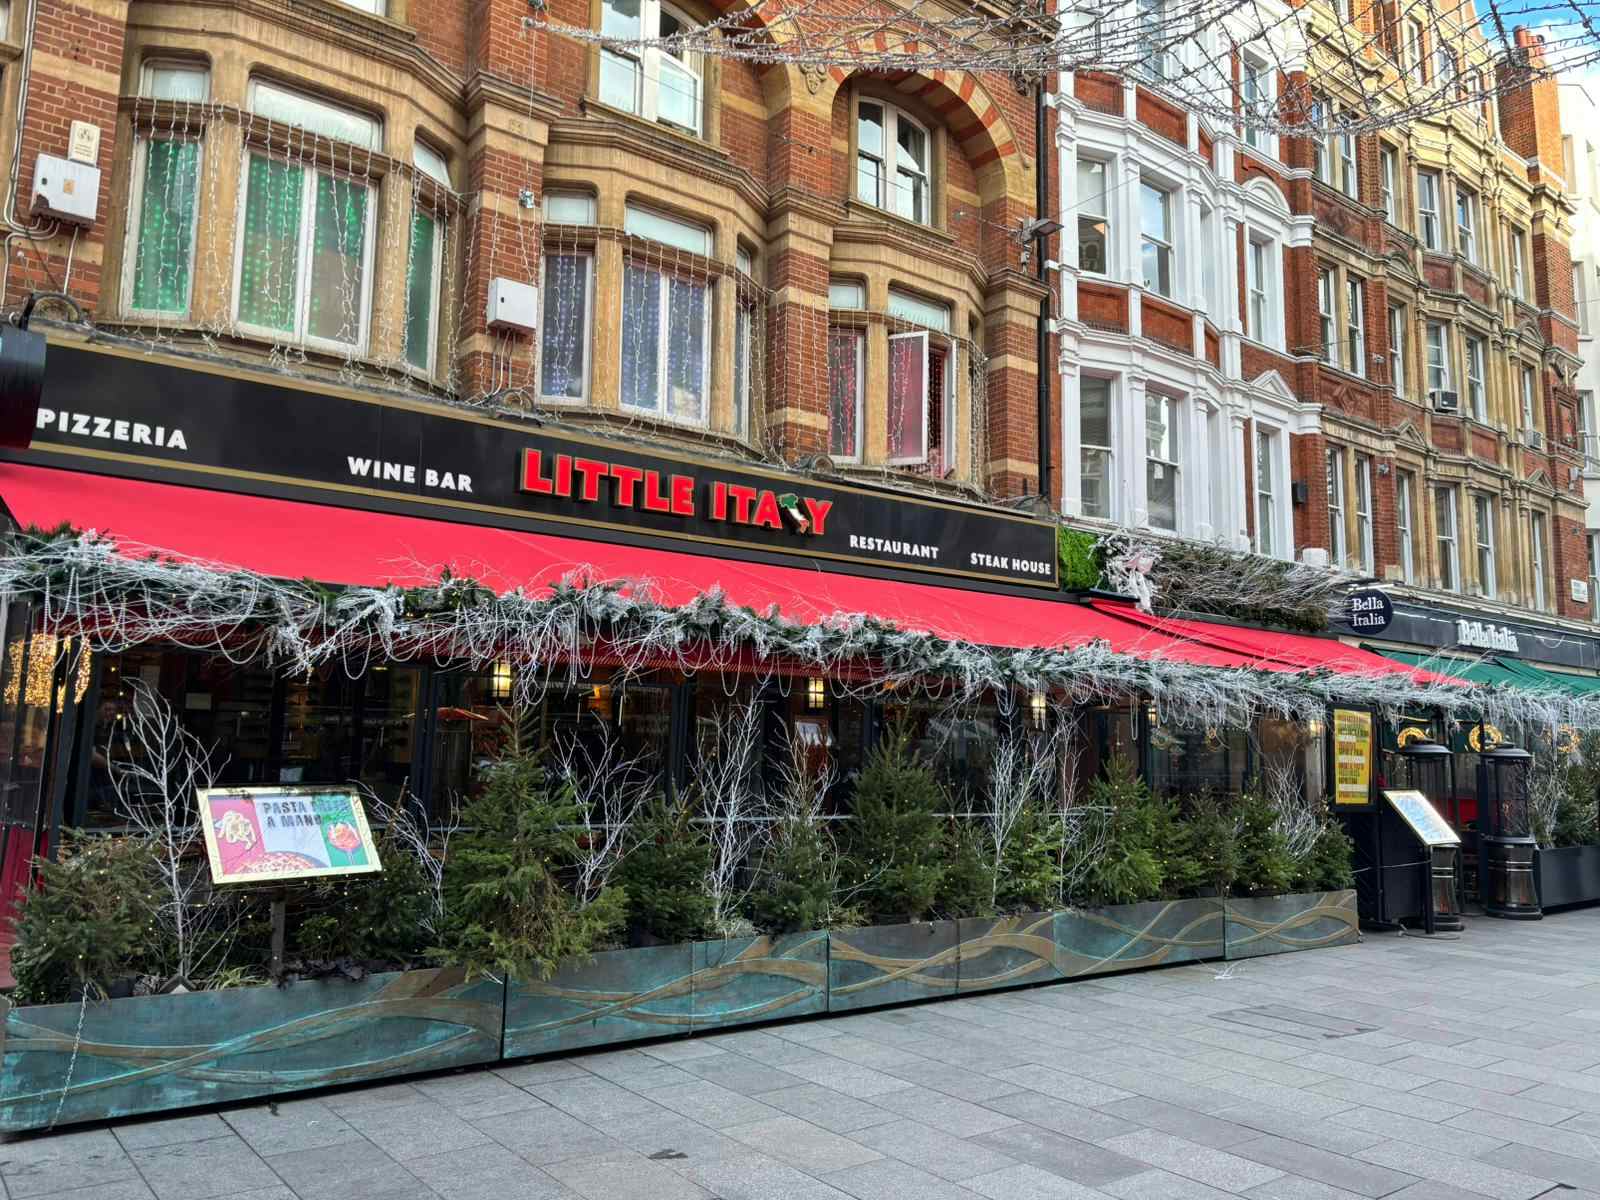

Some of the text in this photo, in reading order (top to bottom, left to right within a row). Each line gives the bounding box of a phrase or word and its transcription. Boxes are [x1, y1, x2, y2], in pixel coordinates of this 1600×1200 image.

[36, 407, 188, 450] PIZZERIA
[347, 456, 473, 493] WINE BAR
[520, 447, 695, 516] LITTLE
[850, 534, 939, 560] RESTAURANT
[970, 552, 1052, 575] STEAK HOUSE
[1352, 597, 1384, 611] Bella
[1352, 612, 1386, 627] Italia
[263, 801, 307, 814] PASTA
[267, 814, 322, 828] A MANO
